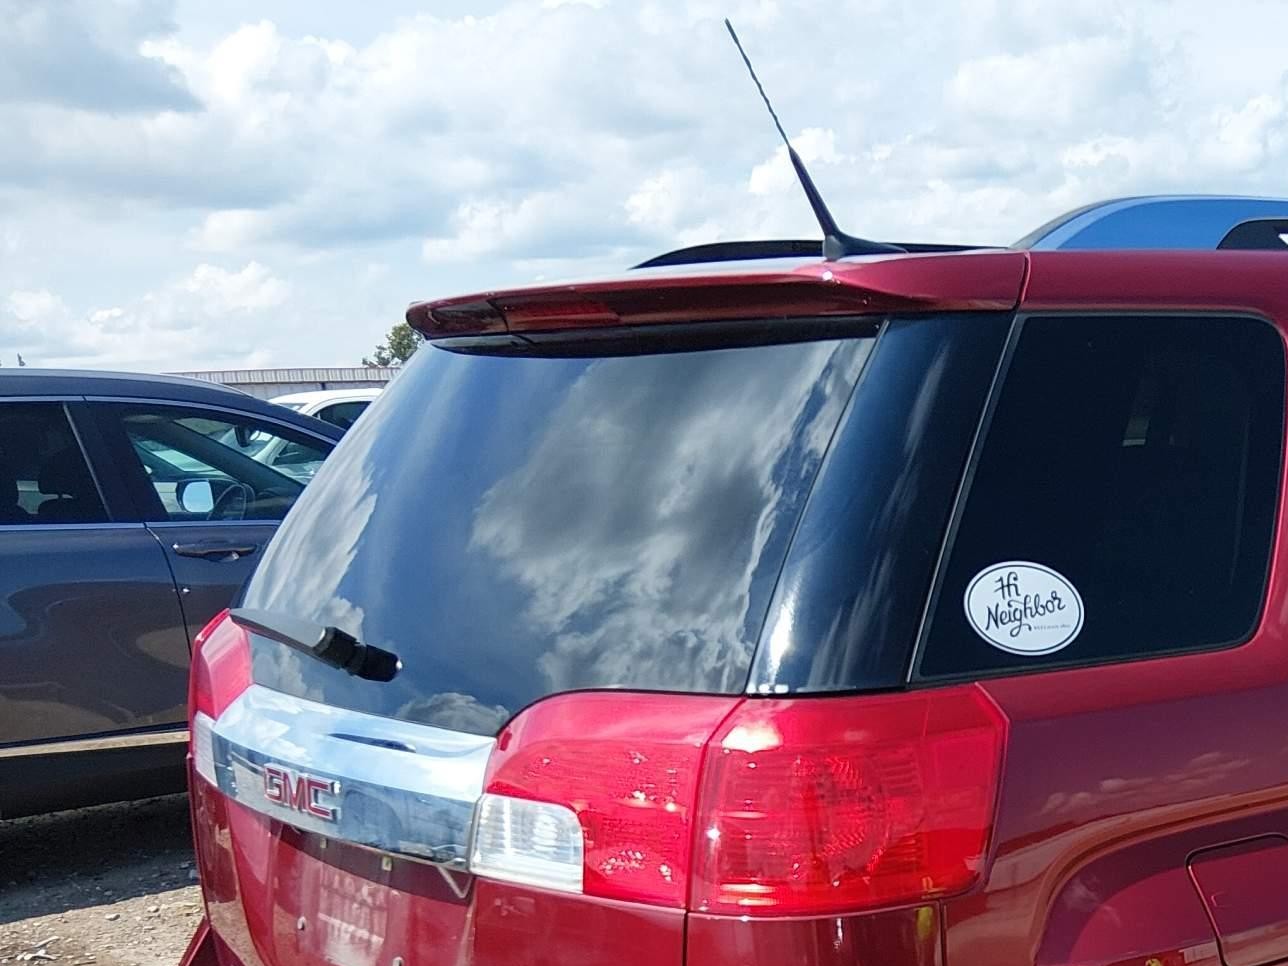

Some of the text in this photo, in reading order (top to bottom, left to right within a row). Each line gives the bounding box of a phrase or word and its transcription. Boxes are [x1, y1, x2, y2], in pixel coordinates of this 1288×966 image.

[994, 571, 1021, 600] Hi
[985, 590, 1066, 638] Neighbor
[263, 763, 342, 822] GMC
